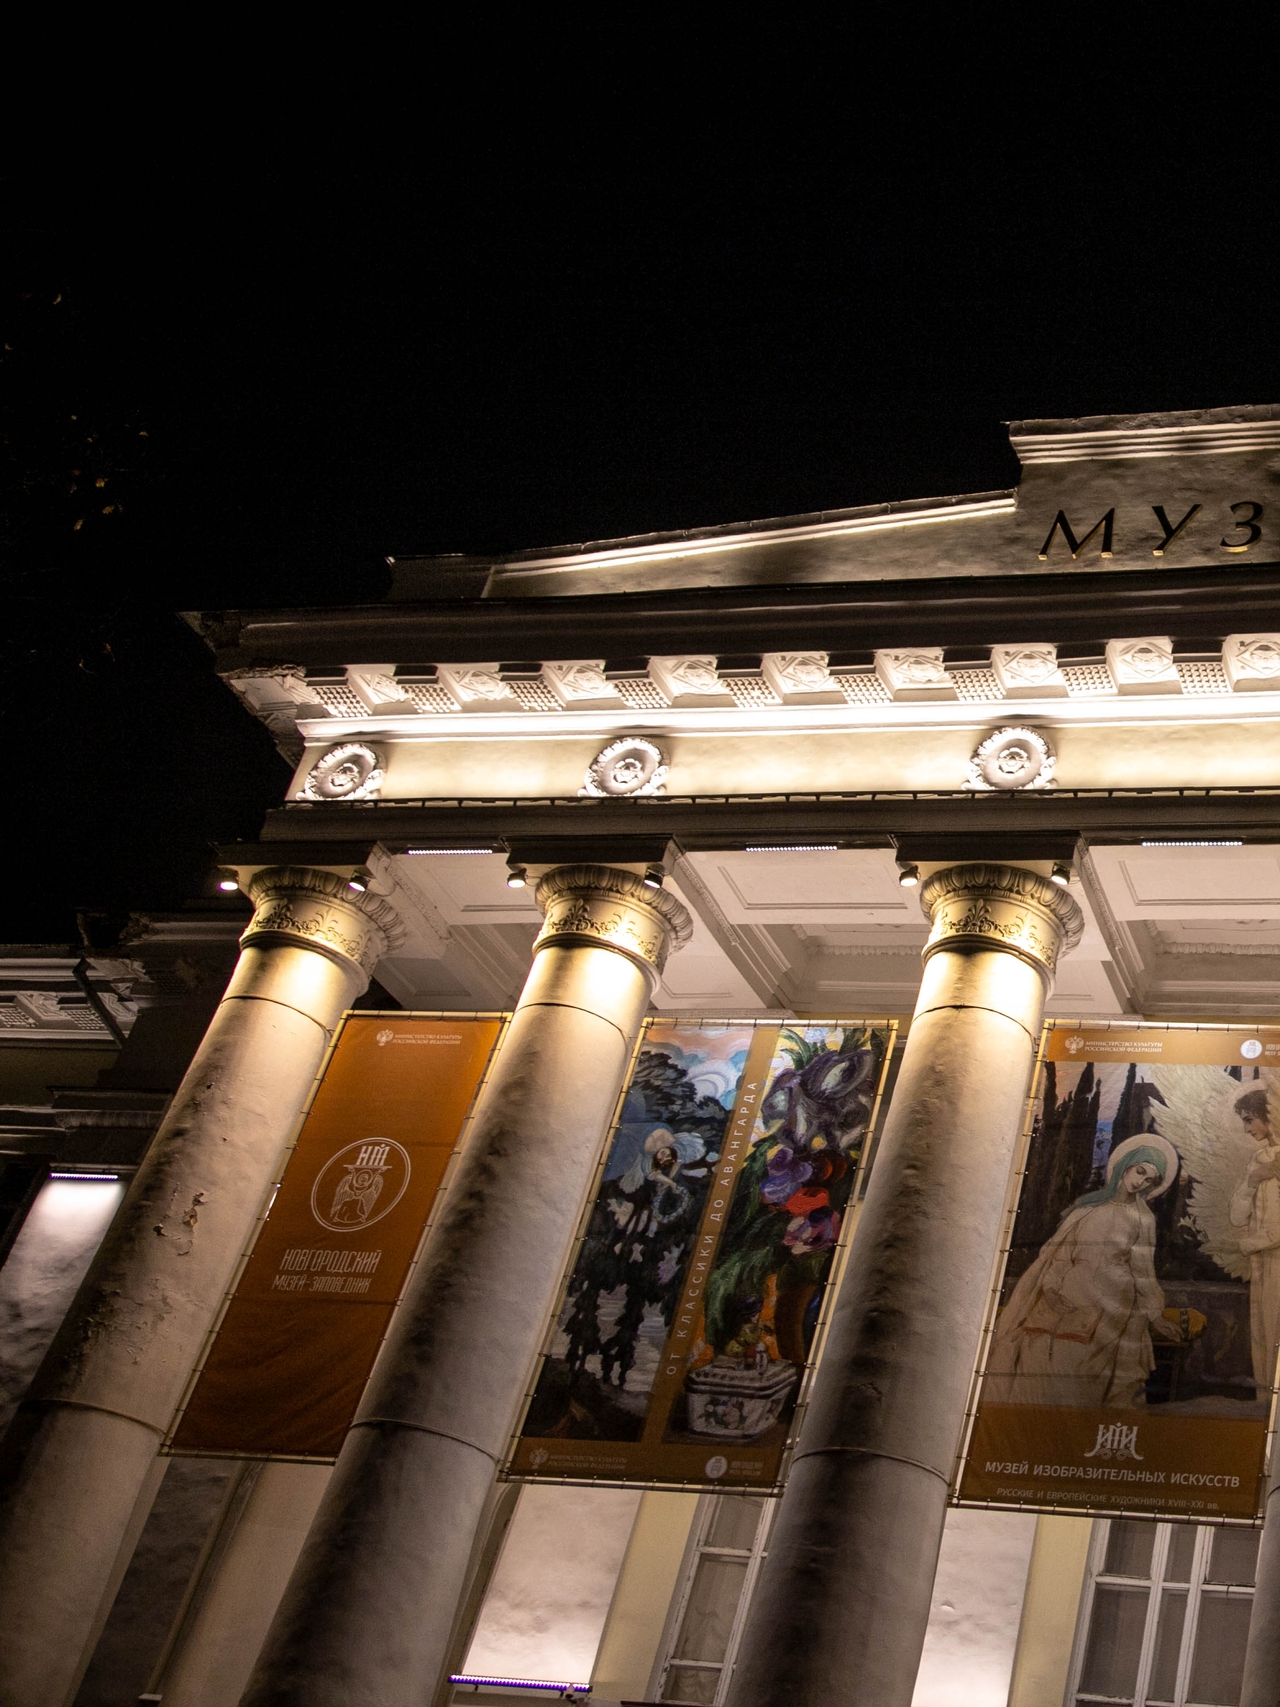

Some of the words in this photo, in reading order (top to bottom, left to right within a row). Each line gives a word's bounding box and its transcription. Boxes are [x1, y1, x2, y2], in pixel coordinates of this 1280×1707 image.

[666, 1353, 680, 1375] ОТ
[677, 1235, 714, 1338] КЛАССИКИ
[710, 1200, 724, 1221] ДО
[721, 1082, 757, 1186] АВАНГАРДА
[279, 1249, 382, 1273] НОВГОРОДСКИЙ
[985, 1461, 1029, 1475] МУЗЕЙ
[1033, 1464, 1165, 1483] ИЗОБРАЗИТЕЛЬНЫХ
[1170, 1472, 1240, 1488] ИСКУССТВ
[997, 1488, 1034, 1498] РУССКИЕ
[1037, 1490, 1044, 1498] И
[1046, 1490, 1107, 1502] ЕВРОПЕЙСКИЕ
[1110, 1495, 1165, 1507] ХУДОЖНИКИ
